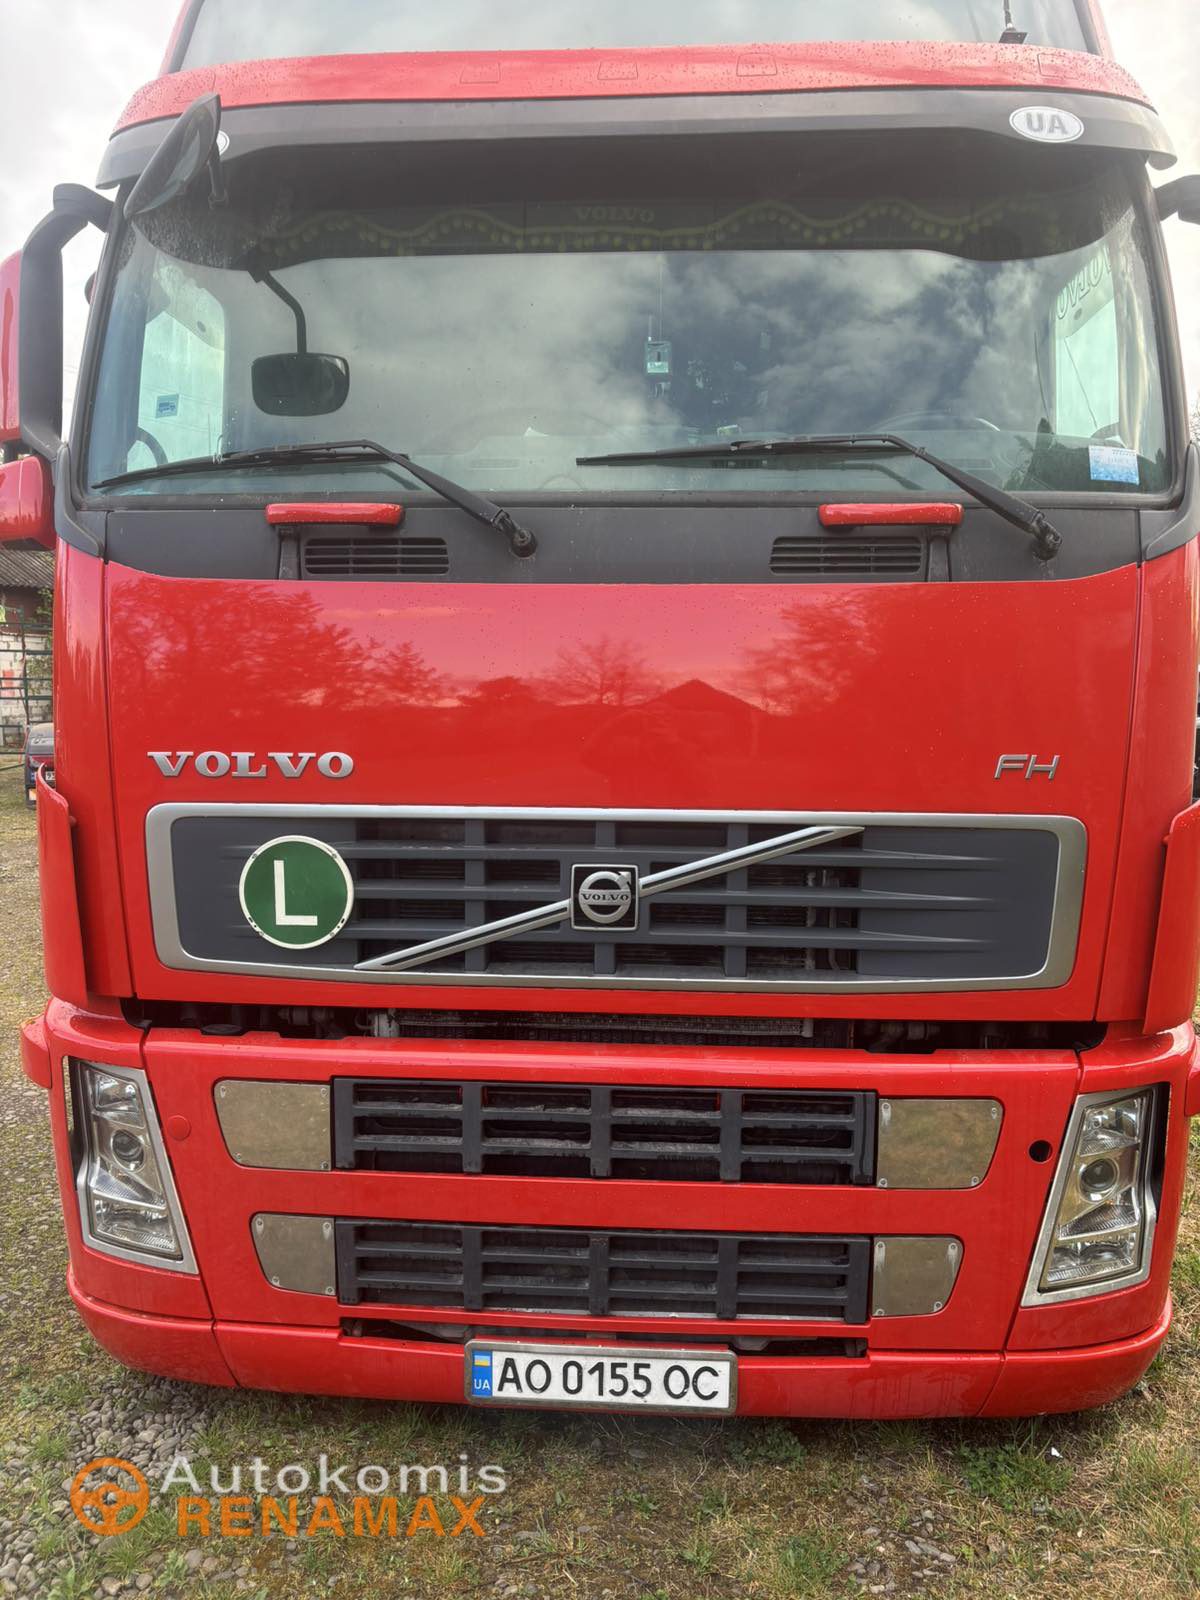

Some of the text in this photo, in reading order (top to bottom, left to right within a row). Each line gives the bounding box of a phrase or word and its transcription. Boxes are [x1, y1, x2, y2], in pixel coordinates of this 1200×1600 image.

[1025, 112, 1068, 134] UA
[575, 206, 656, 223] VOLVO
[147, 751, 354, 778] VOLVO
[994, 754, 1060, 779] FH
[274, 860, 318, 926] L
[580, 893, 630, 901] VOLVO
[473, 1378, 491, 1391] UA
[497, 1357, 720, 1401] AO 0155 OC
